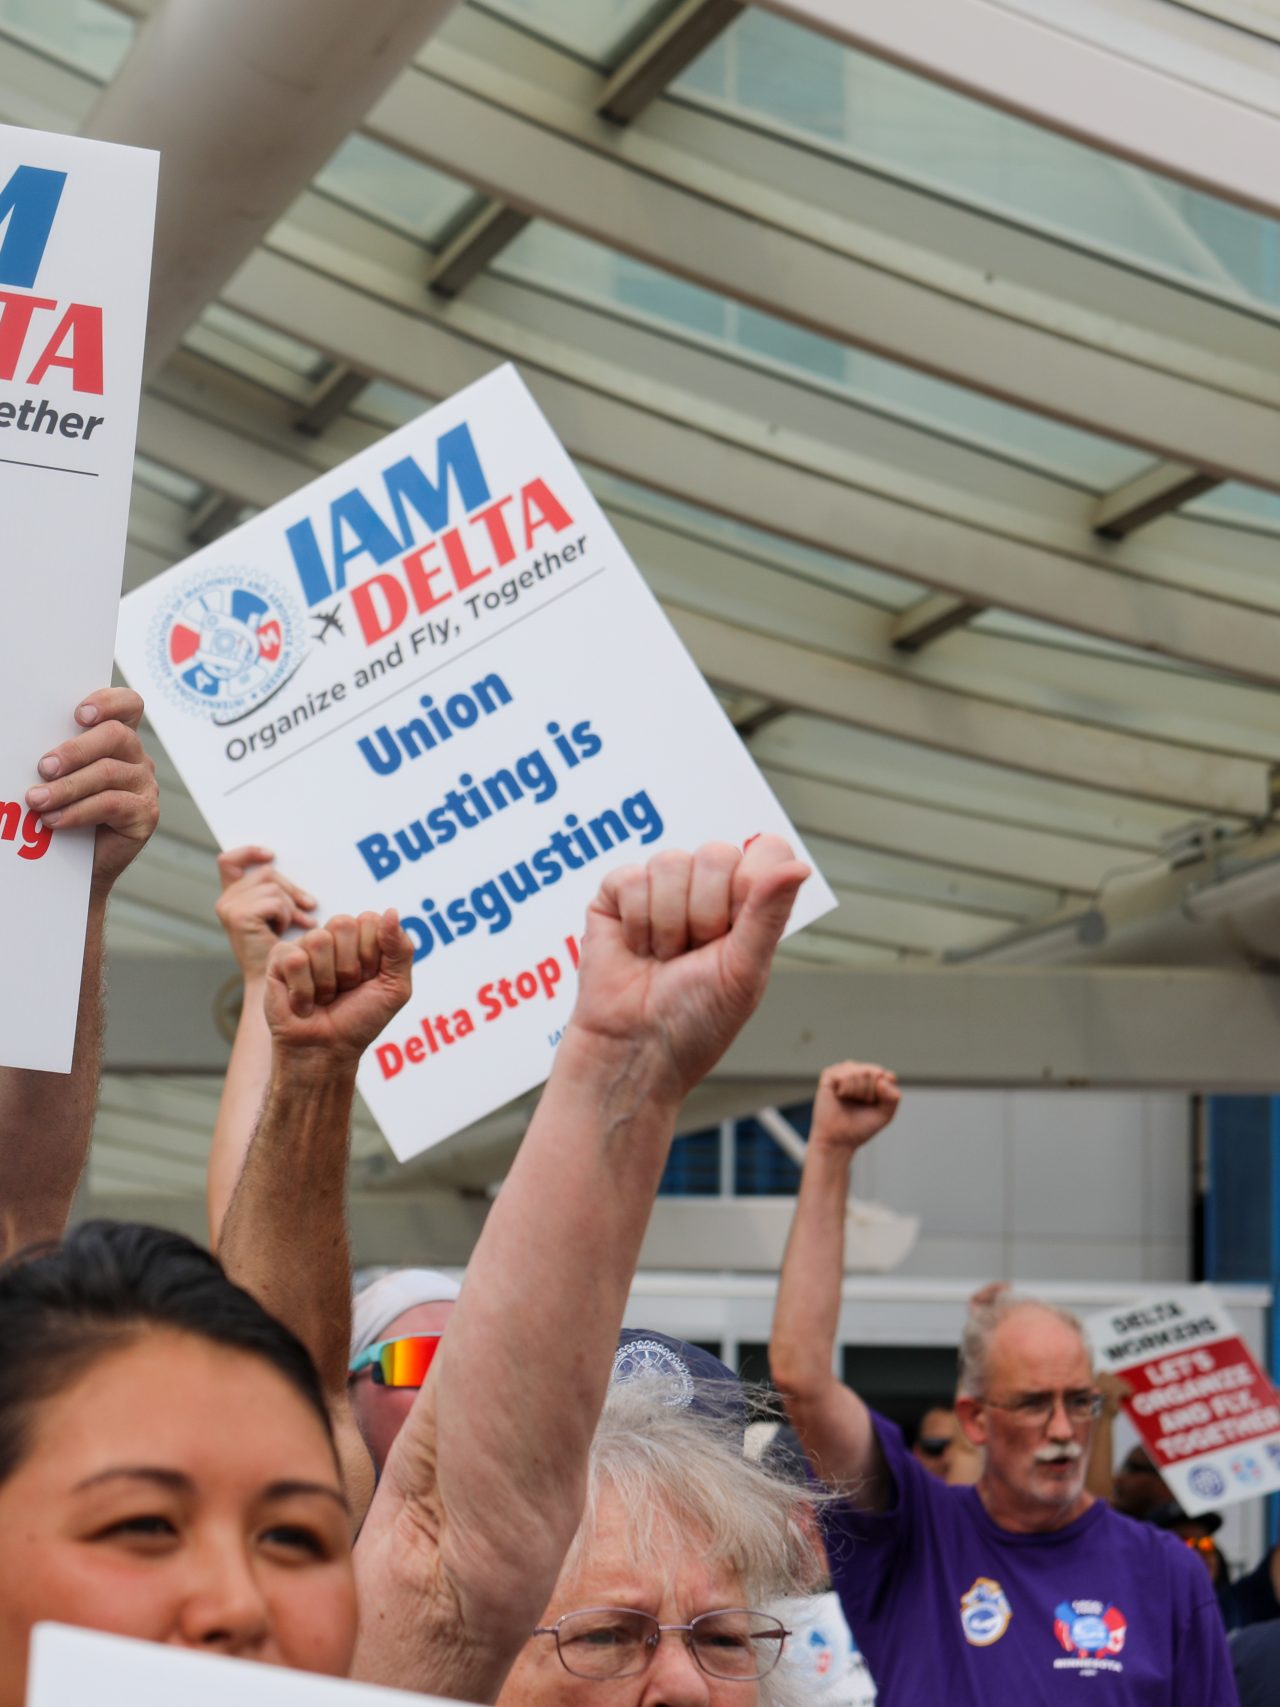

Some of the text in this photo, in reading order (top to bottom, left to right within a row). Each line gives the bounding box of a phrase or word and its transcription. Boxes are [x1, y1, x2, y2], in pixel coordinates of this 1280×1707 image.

[285, 422, 492, 608] IAM
[350, 477, 575, 647] DELTA
[225, 535, 589, 763] Organize and Fly, Together
[356, 673, 513, 778] Union
[355, 720, 604, 883] Busting is
[398, 789, 664, 966] Disgusting
[374, 955, 562, 1081] Delta Stop
[1104, 1315, 1218, 1362] WORKERS
[1110, 1301, 1184, 1335] DELTA
[1143, 1349, 1217, 1387] LET'S
[1130, 1361, 1256, 1416] ORGANIZE
[1157, 1400, 1213, 1435] AND
